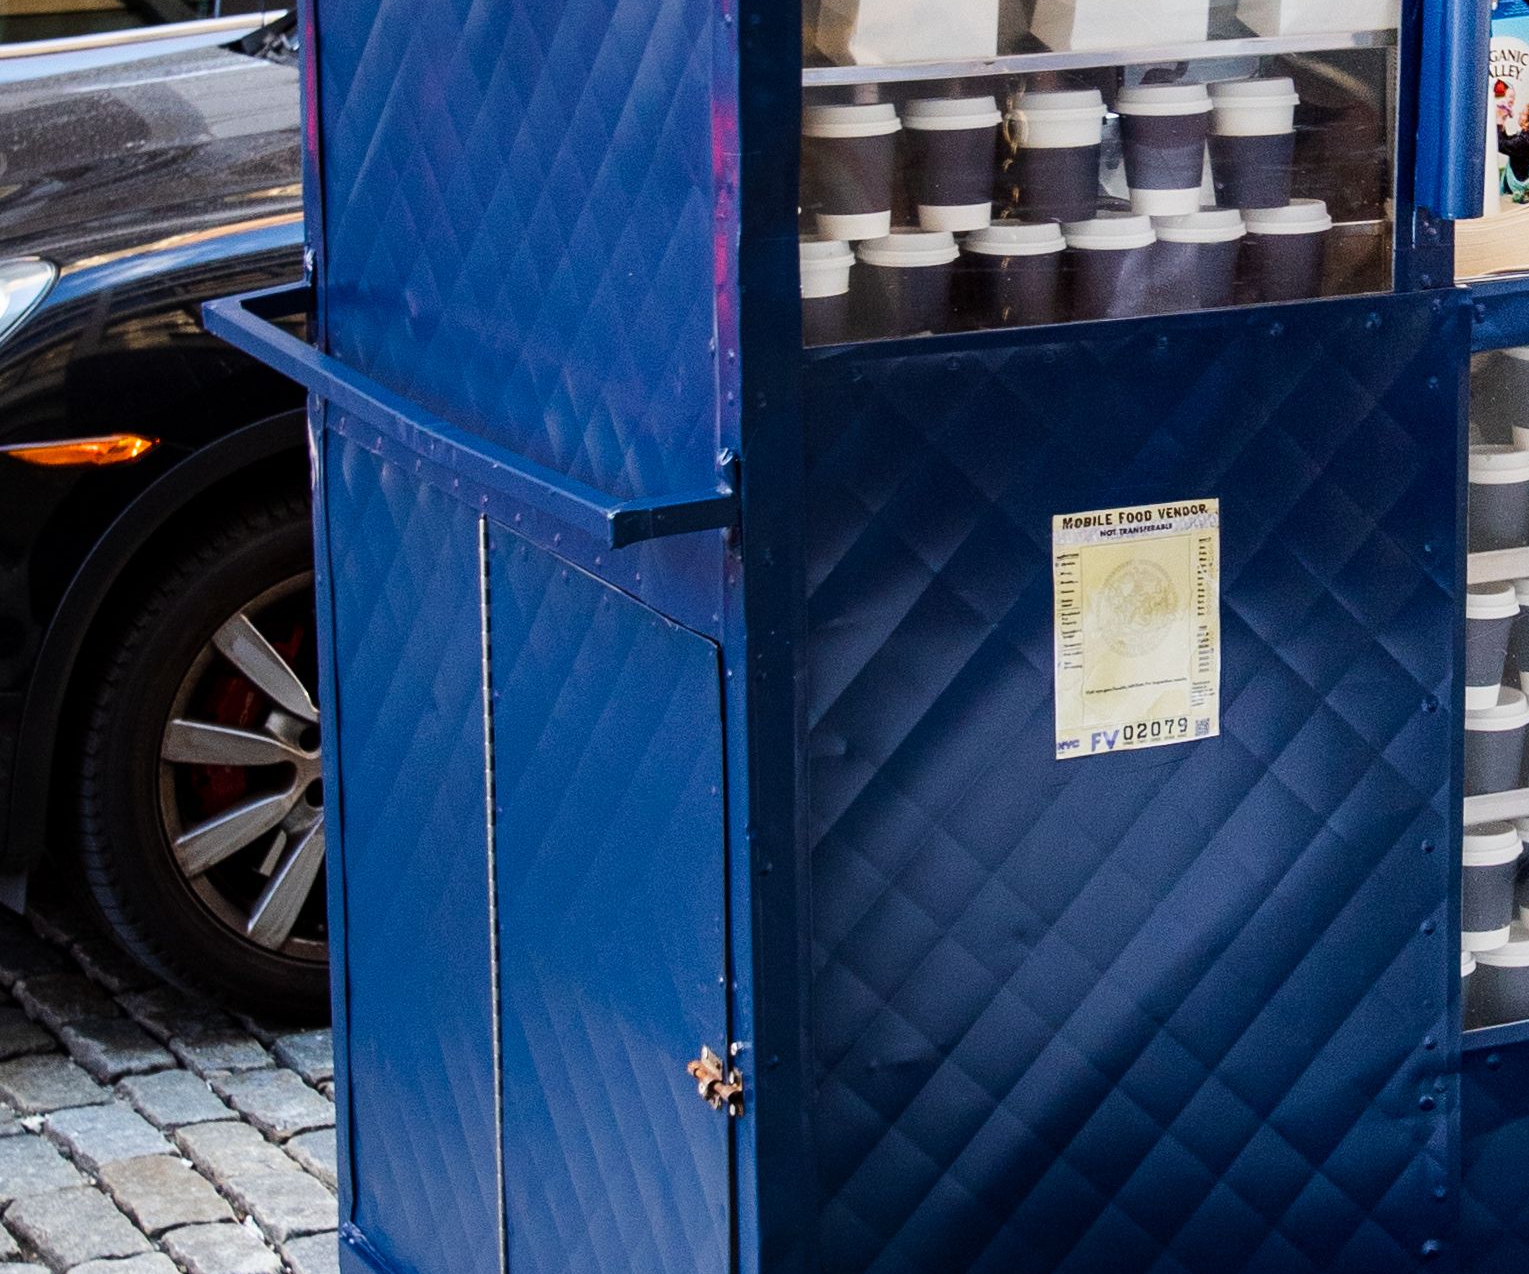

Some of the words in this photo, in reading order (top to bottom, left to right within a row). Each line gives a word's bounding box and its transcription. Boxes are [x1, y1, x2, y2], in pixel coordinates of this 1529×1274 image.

[1489, 49, 1529, 67] GANIC
[1489, 64, 1525, 81] LLEY
[1062, 513, 1113, 530] MOBILE
[1118, 510, 1152, 525] FOOD
[1158, 503, 1208, 520] VENDOR
[1100, 529, 1117, 538] NOT
[1119, 523, 1173, 537] TRANSFERABLE
[1091, 729, 1120, 752] FV
[1123, 717, 1188, 741] 02079
